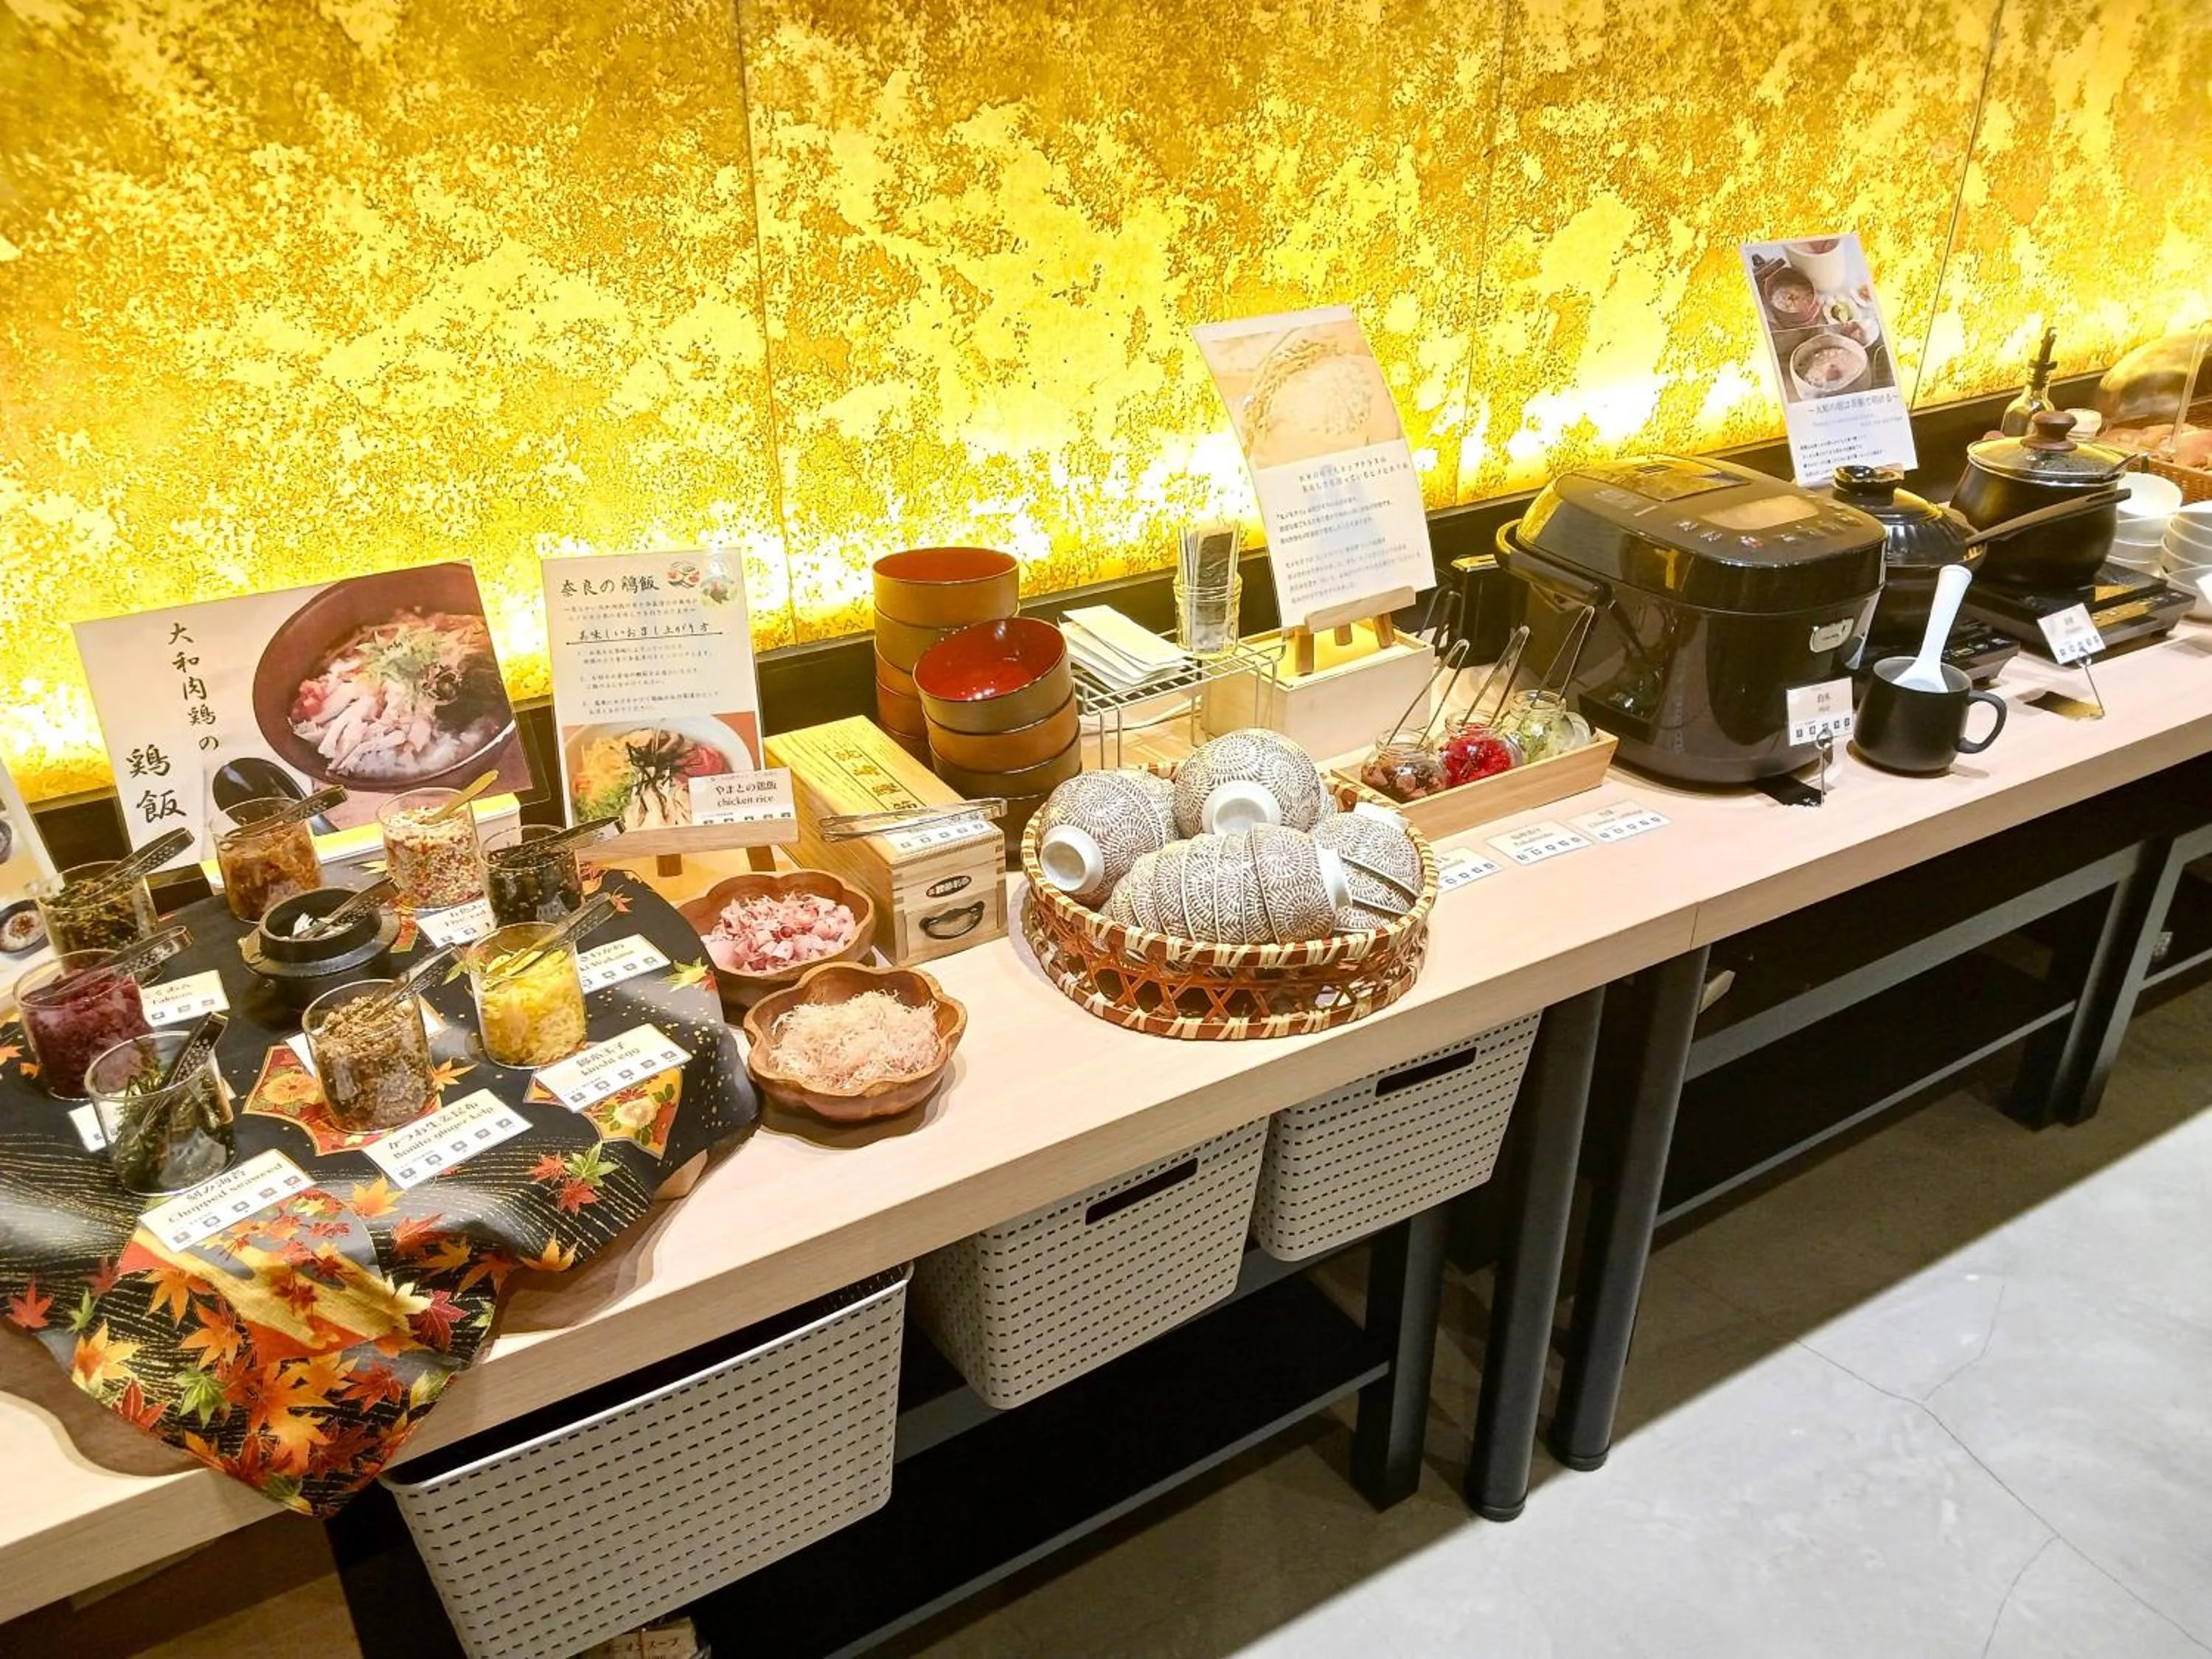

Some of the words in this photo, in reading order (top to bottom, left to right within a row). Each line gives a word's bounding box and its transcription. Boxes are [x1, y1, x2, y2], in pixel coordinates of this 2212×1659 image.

[168, 622, 219, 751] 大和肉鶏の
[126, 743, 187, 824] 鶏飯
[717, 796, 753, 807] chicken
[756, 794, 775, 804] rice
[392, 1137, 433, 1160] Bonito
[167, 1187, 226, 1224] Chopped
